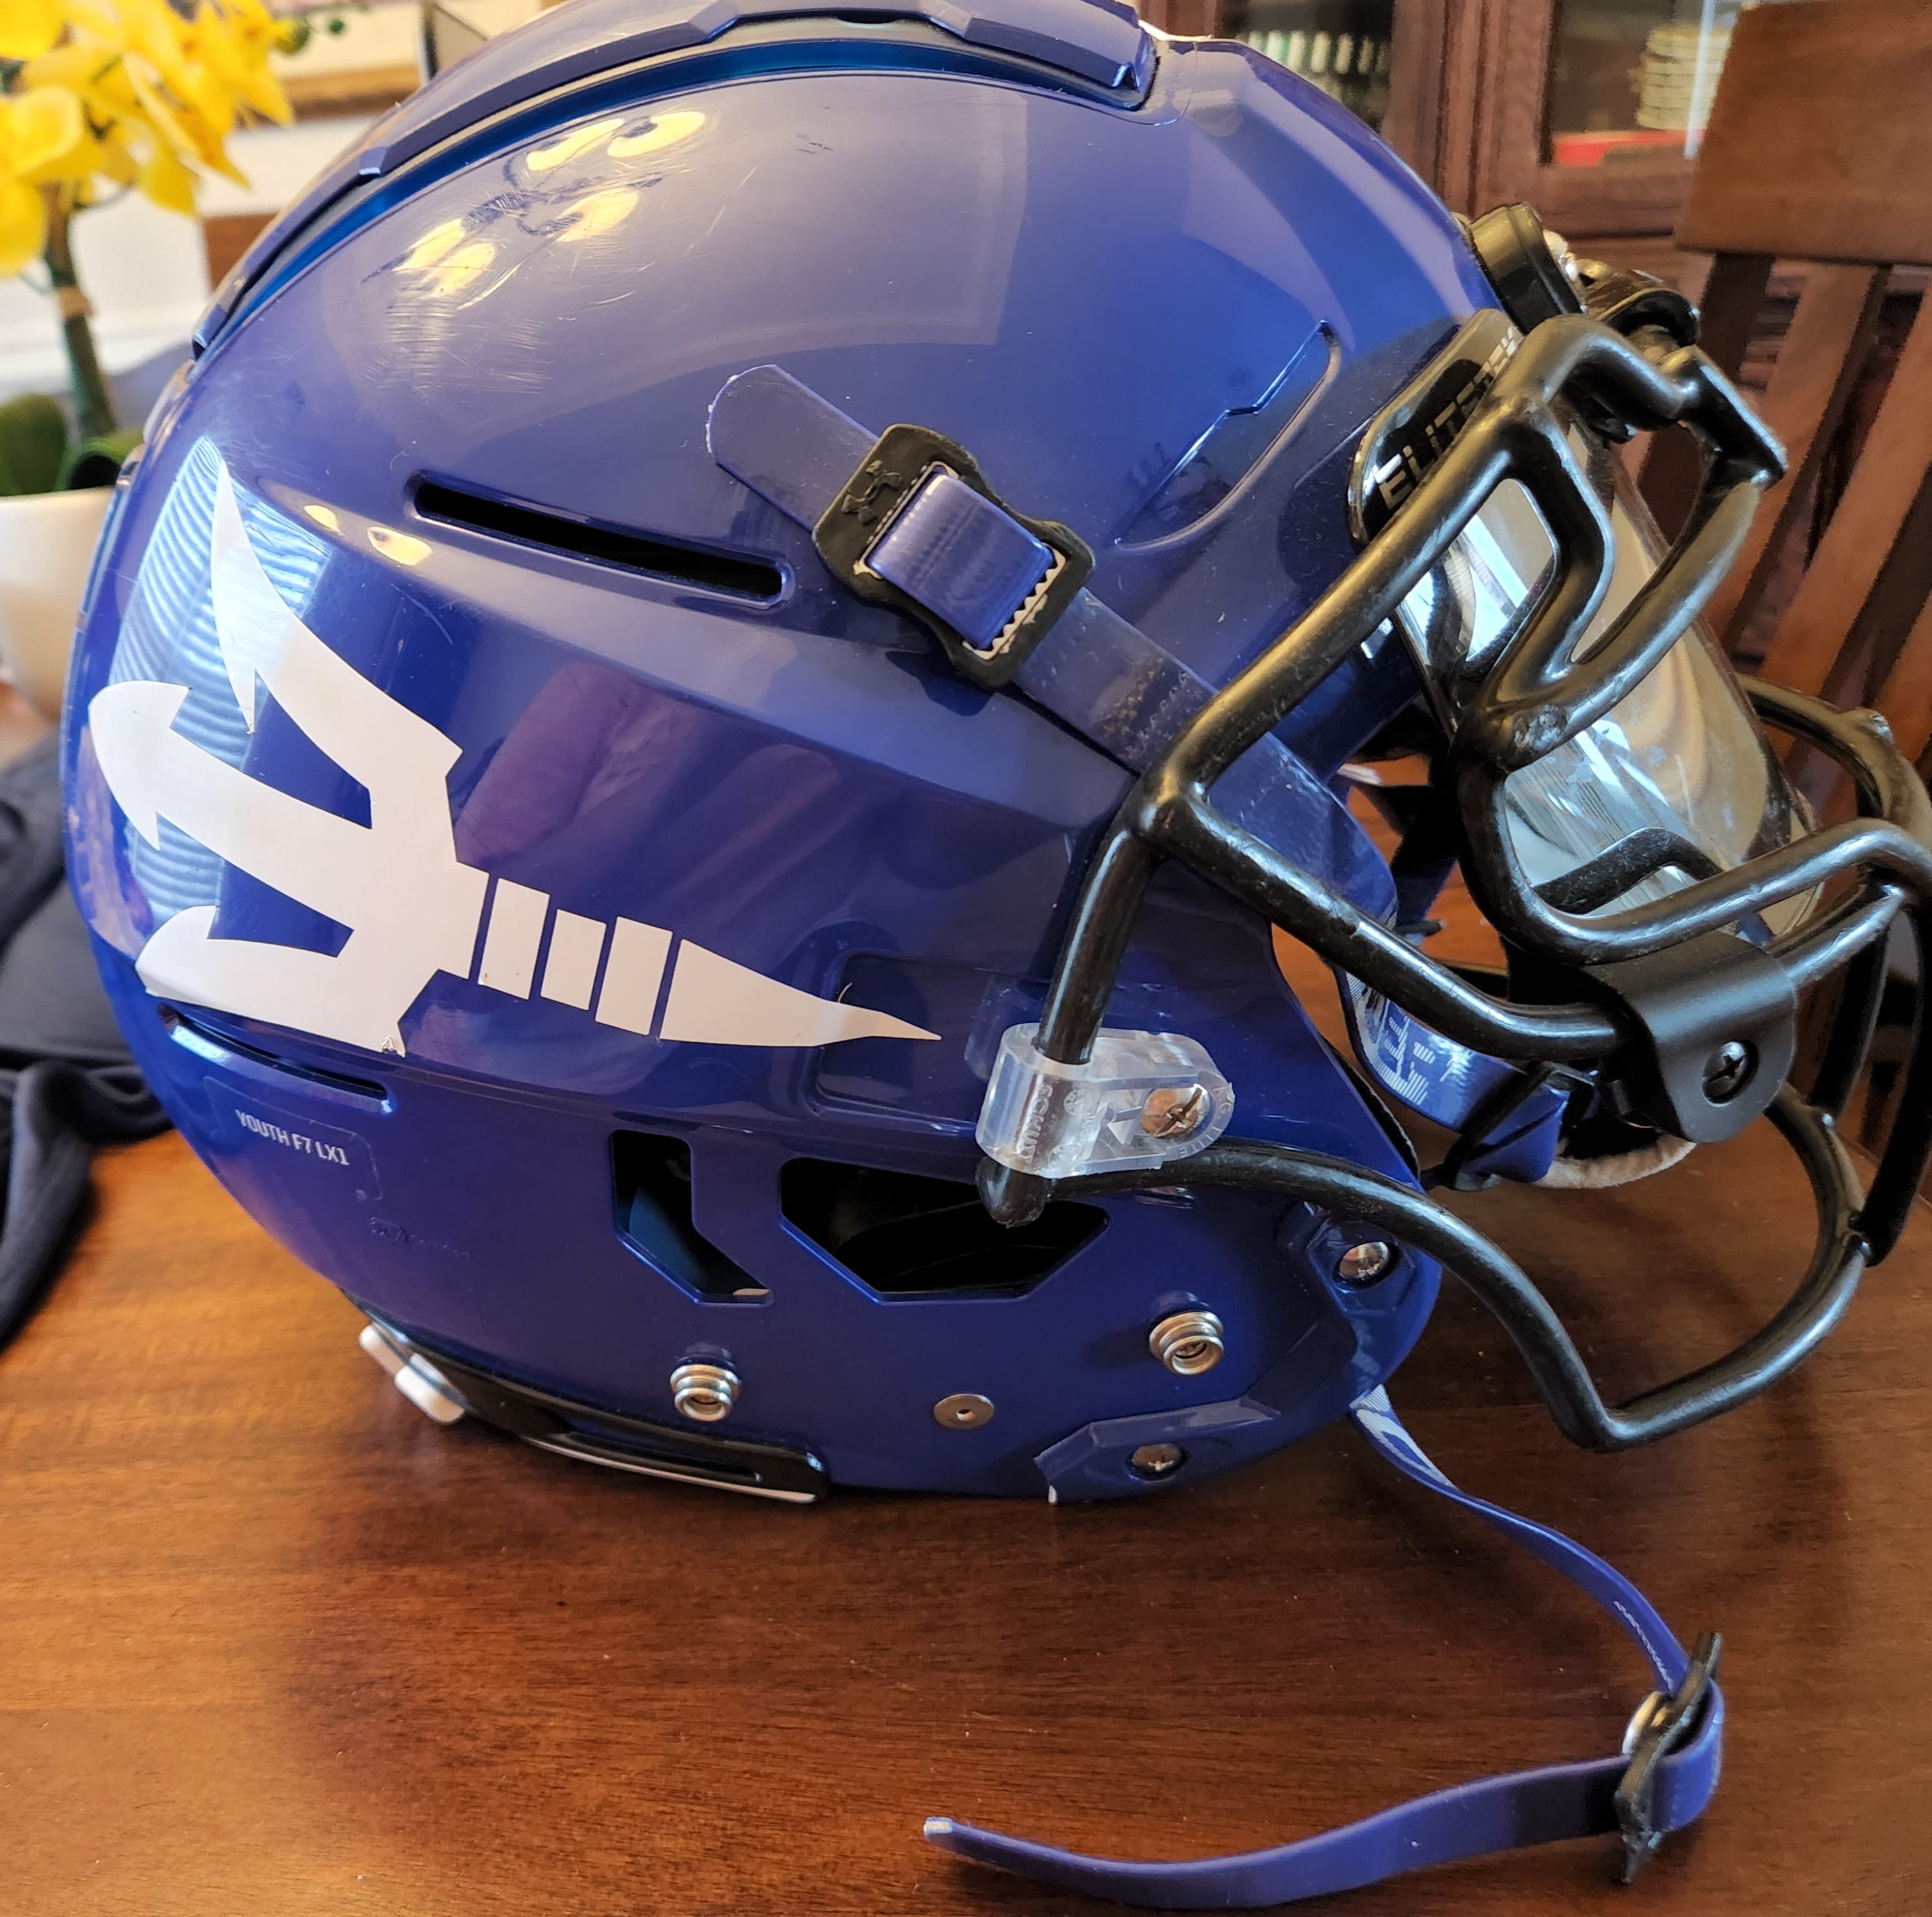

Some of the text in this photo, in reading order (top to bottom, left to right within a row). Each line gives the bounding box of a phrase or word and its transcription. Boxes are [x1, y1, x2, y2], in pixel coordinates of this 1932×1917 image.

[235, 1109, 290, 1146] YOUTH
[291, 1133, 311, 1154] F7
[1020, 1084, 1053, 1164] SCHUTT
